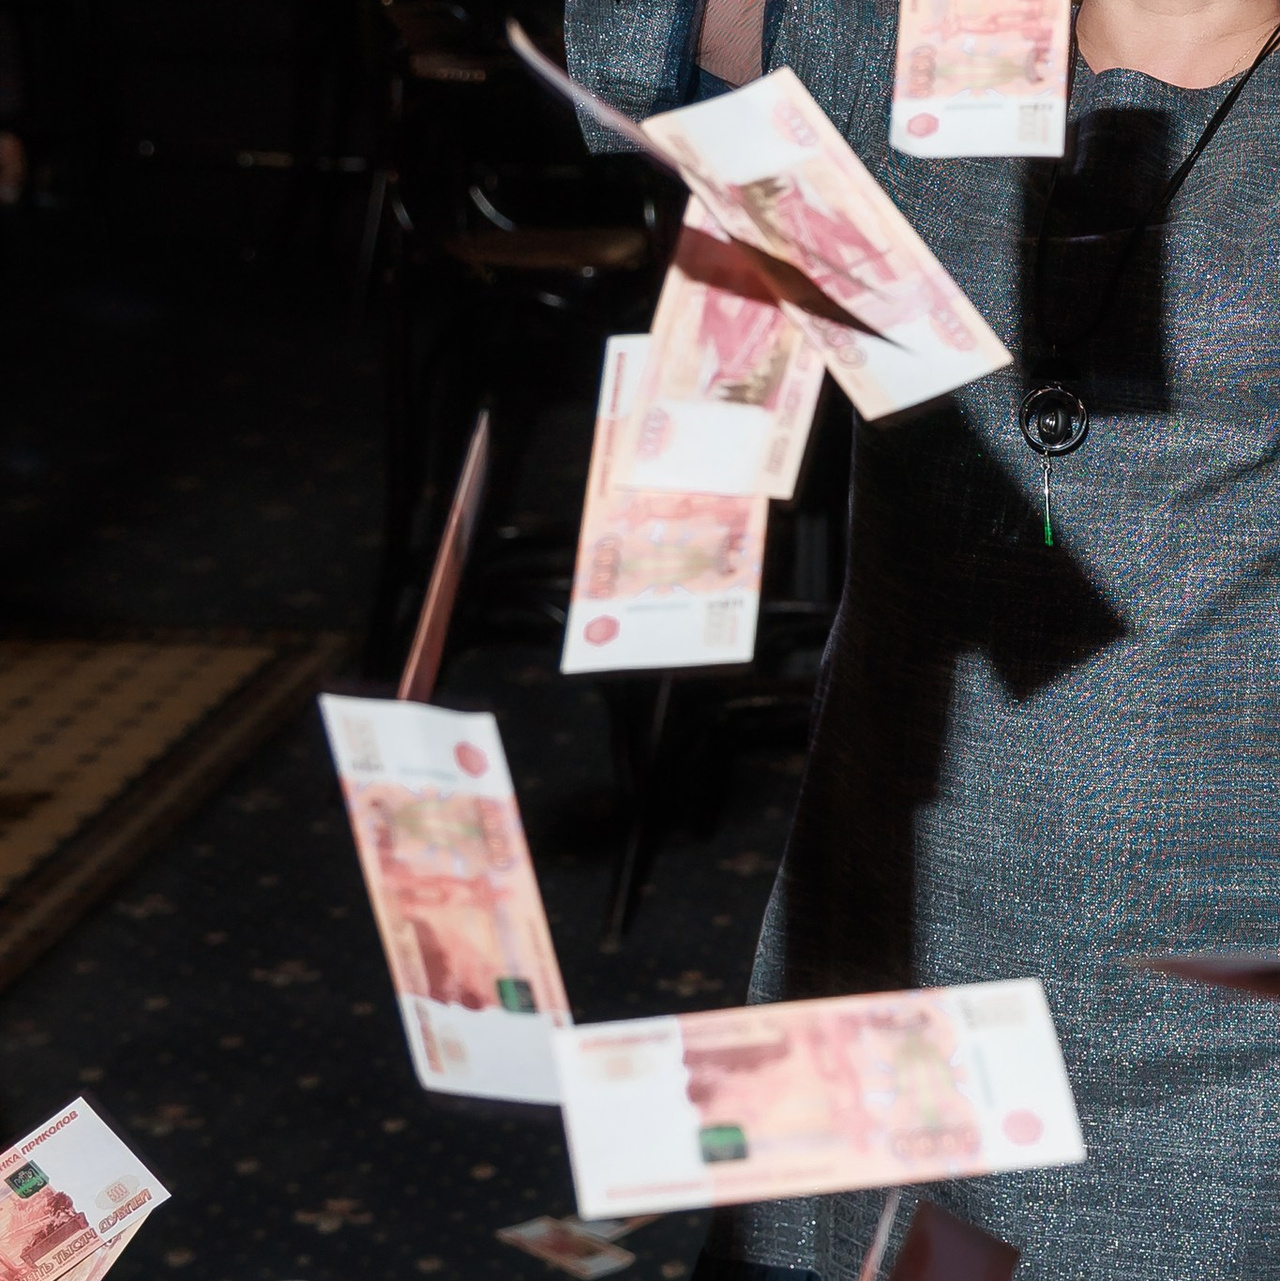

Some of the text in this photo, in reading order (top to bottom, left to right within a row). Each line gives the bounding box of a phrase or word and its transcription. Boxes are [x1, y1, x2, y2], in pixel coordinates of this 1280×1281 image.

[21, 1110, 78, 1155] ПРИКОЛОВ
[52, 1227, 98, 1265] ТЫСЯЧ
[98, 1188, 153, 1234] ДУБЛЕЙ
